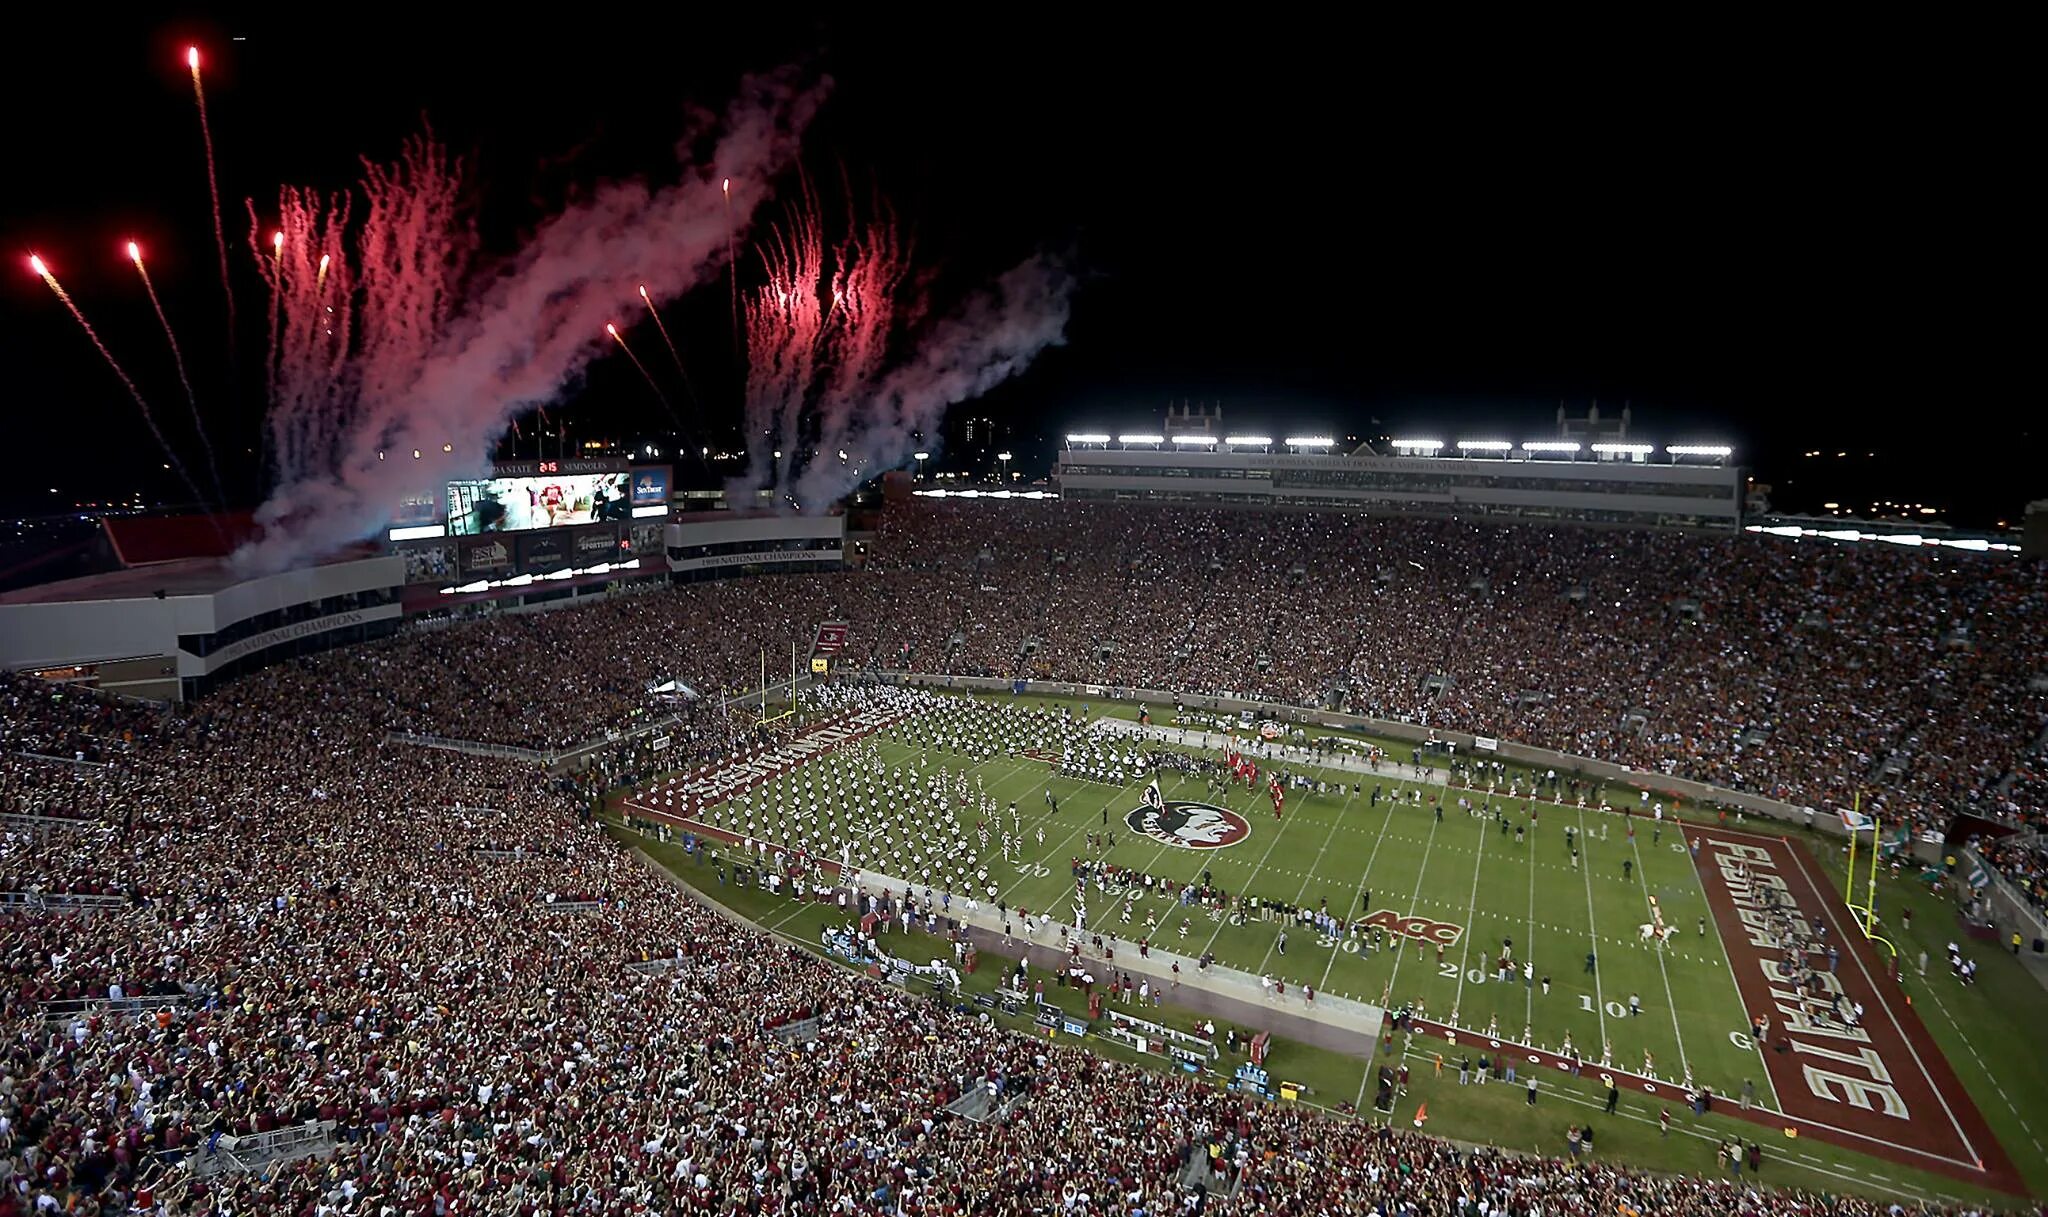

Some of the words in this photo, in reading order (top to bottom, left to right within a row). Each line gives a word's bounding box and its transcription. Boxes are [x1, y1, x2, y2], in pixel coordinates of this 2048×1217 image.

[764, 551, 817, 562] CHAMPIONS
[243, 629, 290, 650] NATIONAL
[294, 612, 363, 637] CHAMPIONS
[1354, 909, 1465, 946] ACC
[1437, 961, 1487, 985] 20
[1578, 993, 1628, 1019] 10
